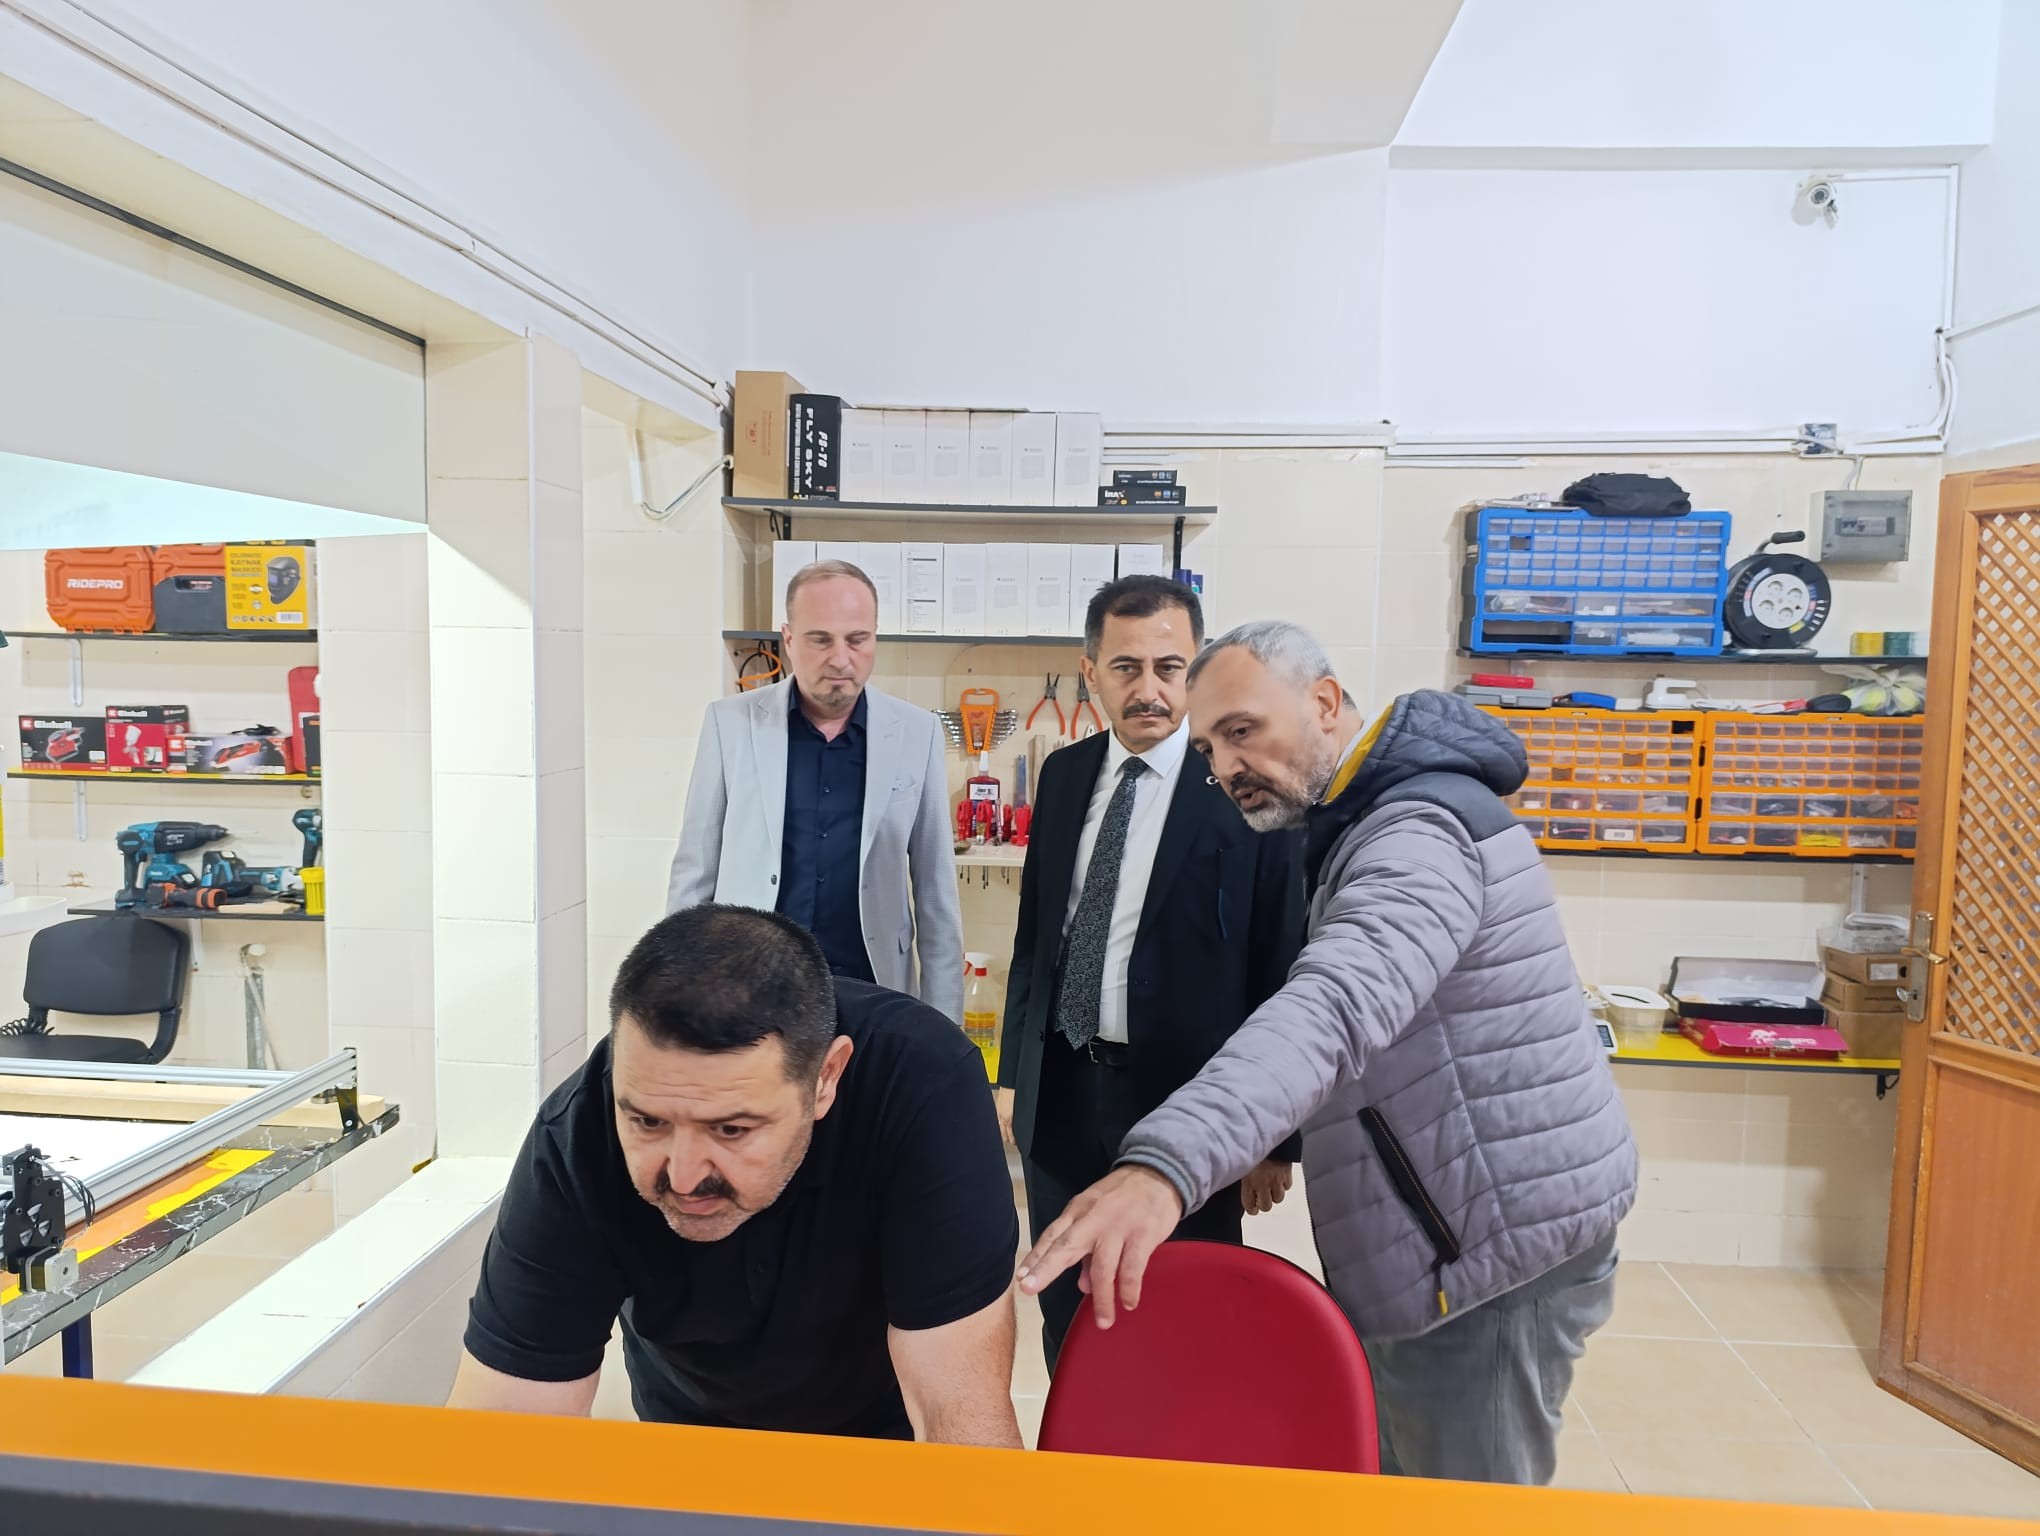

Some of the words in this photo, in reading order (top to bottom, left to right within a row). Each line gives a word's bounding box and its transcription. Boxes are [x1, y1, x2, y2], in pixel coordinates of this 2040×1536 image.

[806, 407, 814, 443] FLY
[804, 448, 813, 489] SKY
[67, 578, 123, 590] RIDEPRO
